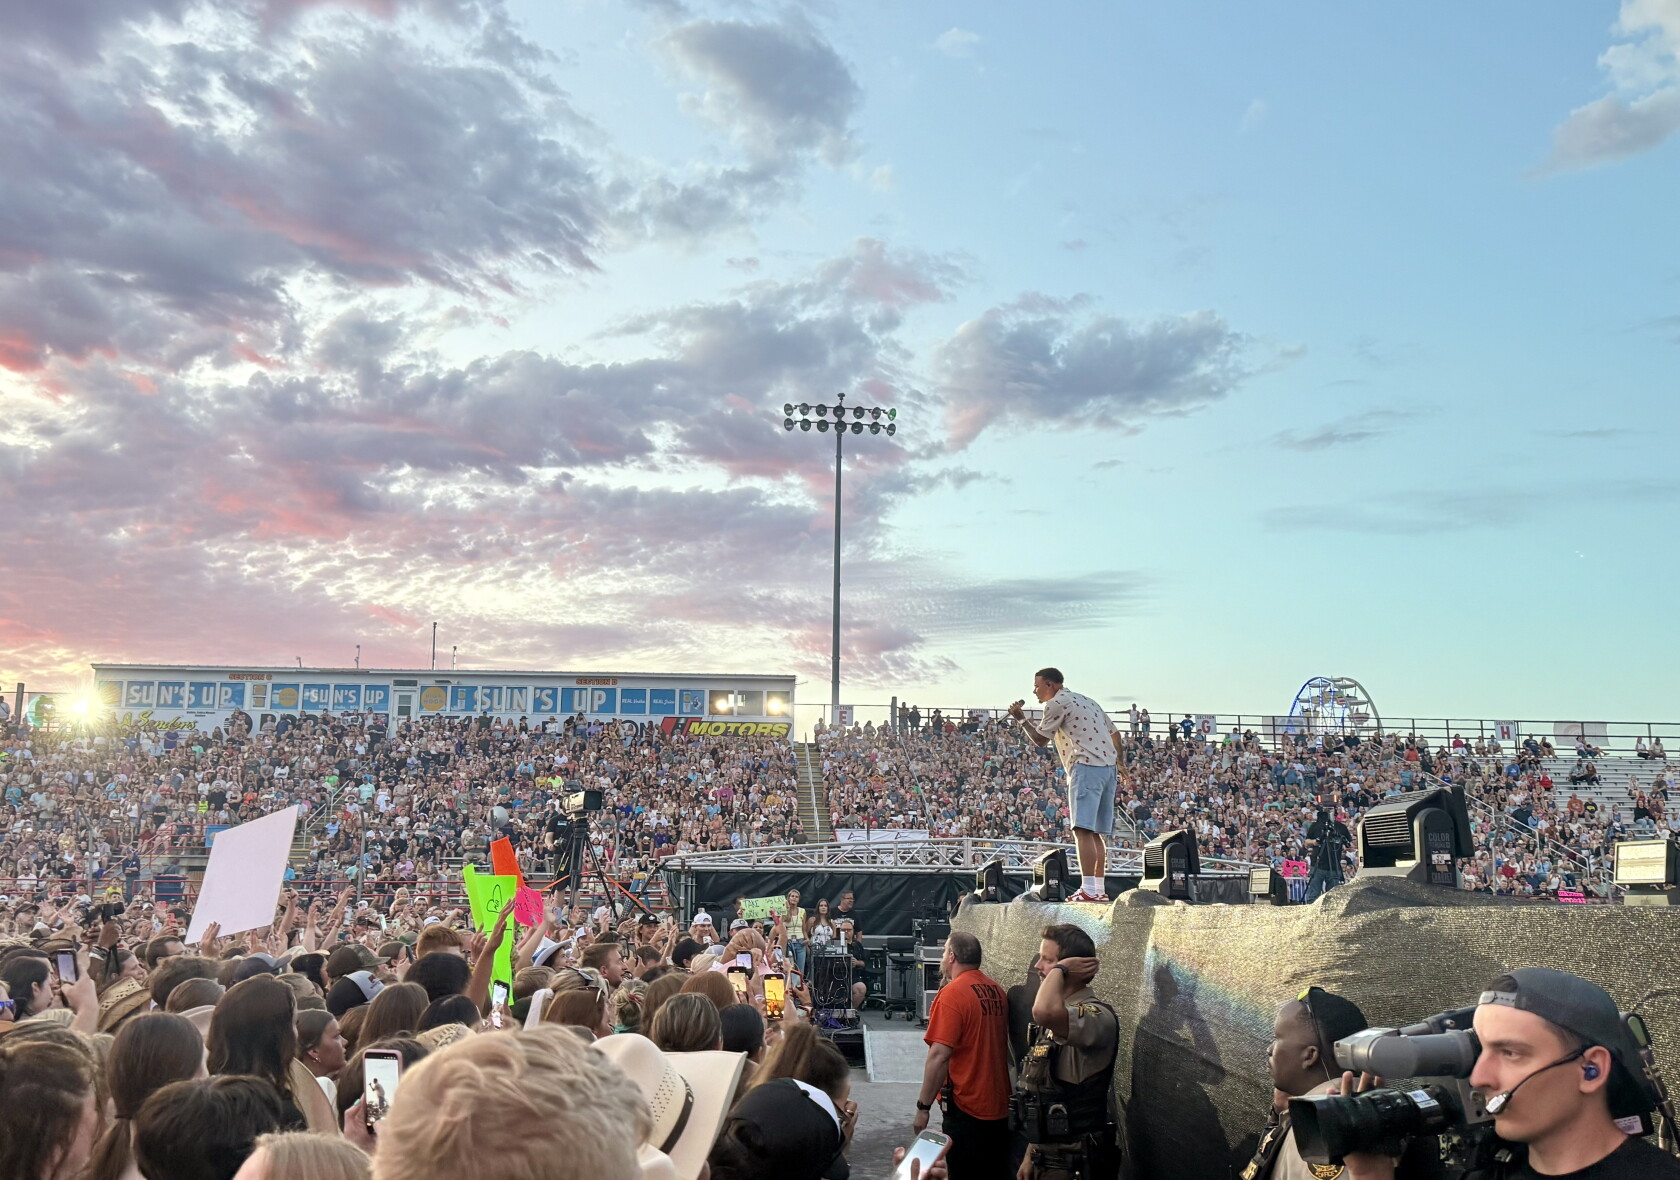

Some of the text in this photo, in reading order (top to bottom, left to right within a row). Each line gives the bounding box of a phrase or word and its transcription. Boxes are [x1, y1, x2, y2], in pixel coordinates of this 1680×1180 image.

[575, 678, 610, 686] SECTION
[129, 684, 232, 706] SUN'S UP
[309, 688, 357, 703] SUN'S
[365, 690, 384, 704] UP
[473, 688, 607, 712] SUN'S UP
[139, 710, 197, 730] Snders
[839, 711, 847, 724] E
[689, 721, 789, 737] MOTORS
[1201, 719, 1211, 733] G
[1500, 725, 1511, 739] H
[1428, 833, 1450, 841] COLOR
